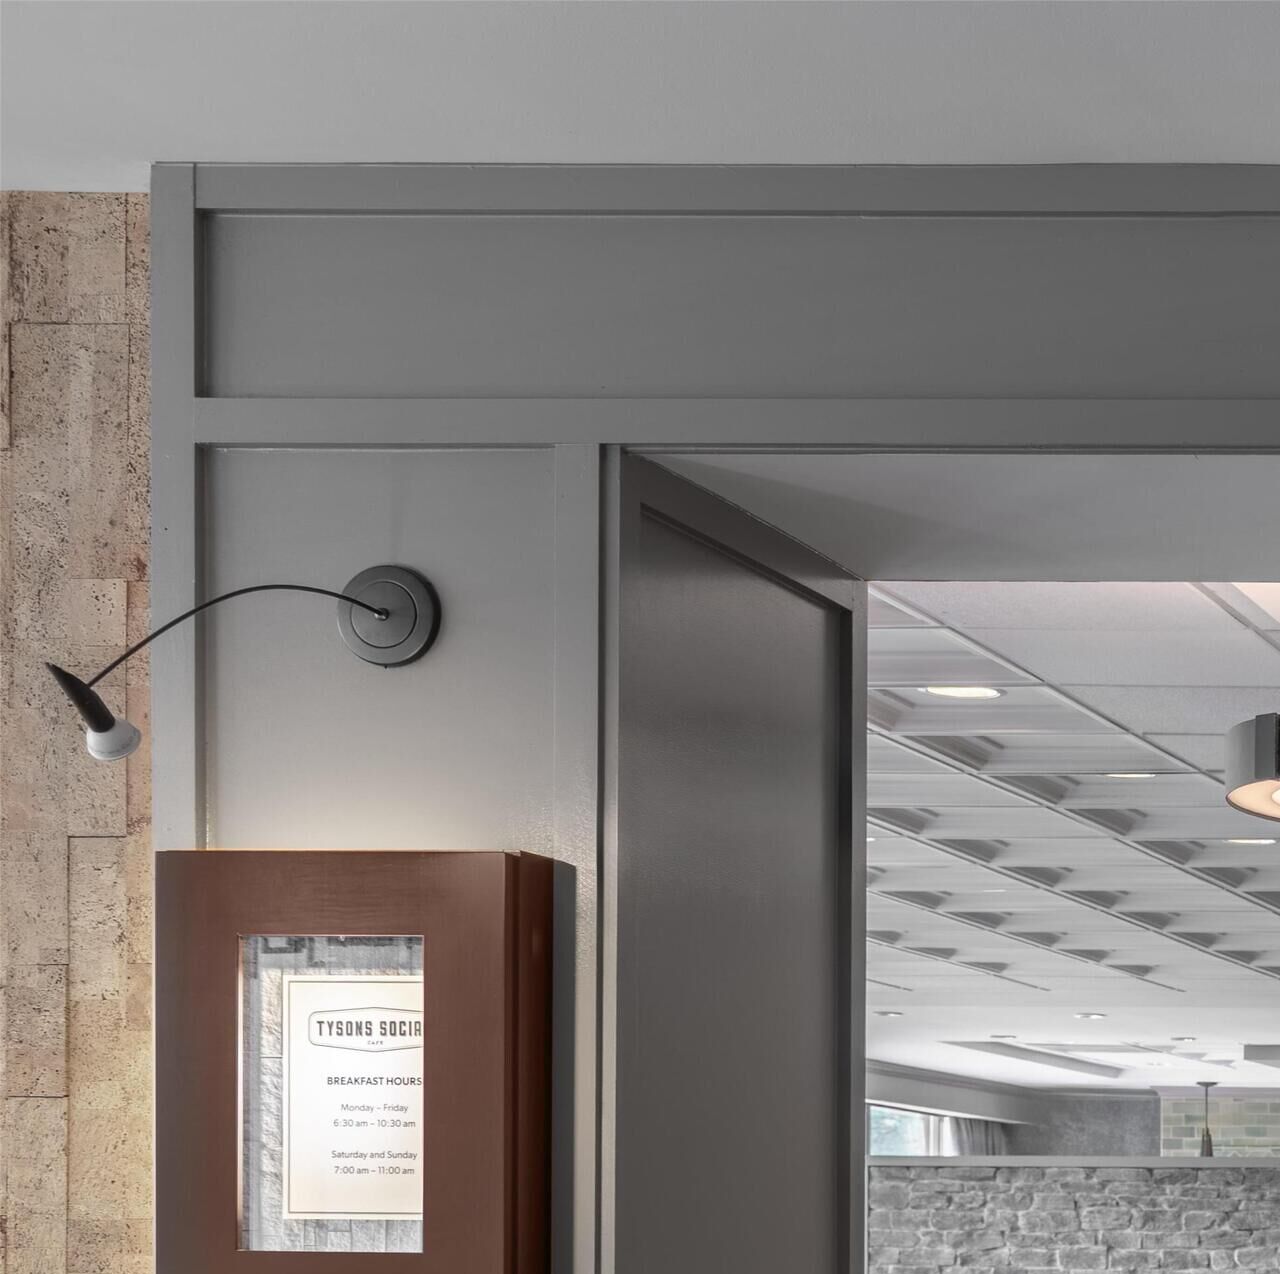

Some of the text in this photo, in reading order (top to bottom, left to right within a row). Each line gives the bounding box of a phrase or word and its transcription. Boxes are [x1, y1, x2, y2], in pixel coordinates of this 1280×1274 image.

[317, 1020, 422, 1036] TYSONS SOCIA
[327, 1077, 422, 1086] BREAKFAST HOURS
[341, 1104, 374, 1114] Monday
[383, 1104, 408, 1114] Friday
[333, 1119, 354, 1127] 6:30
[377, 1119, 402, 1127] 10:30
[331, 1150, 418, 1160] Saturday and Sunday
[334, 1166, 355, 1174] 7:00
[378, 1166, 400, 1174] 11:00
